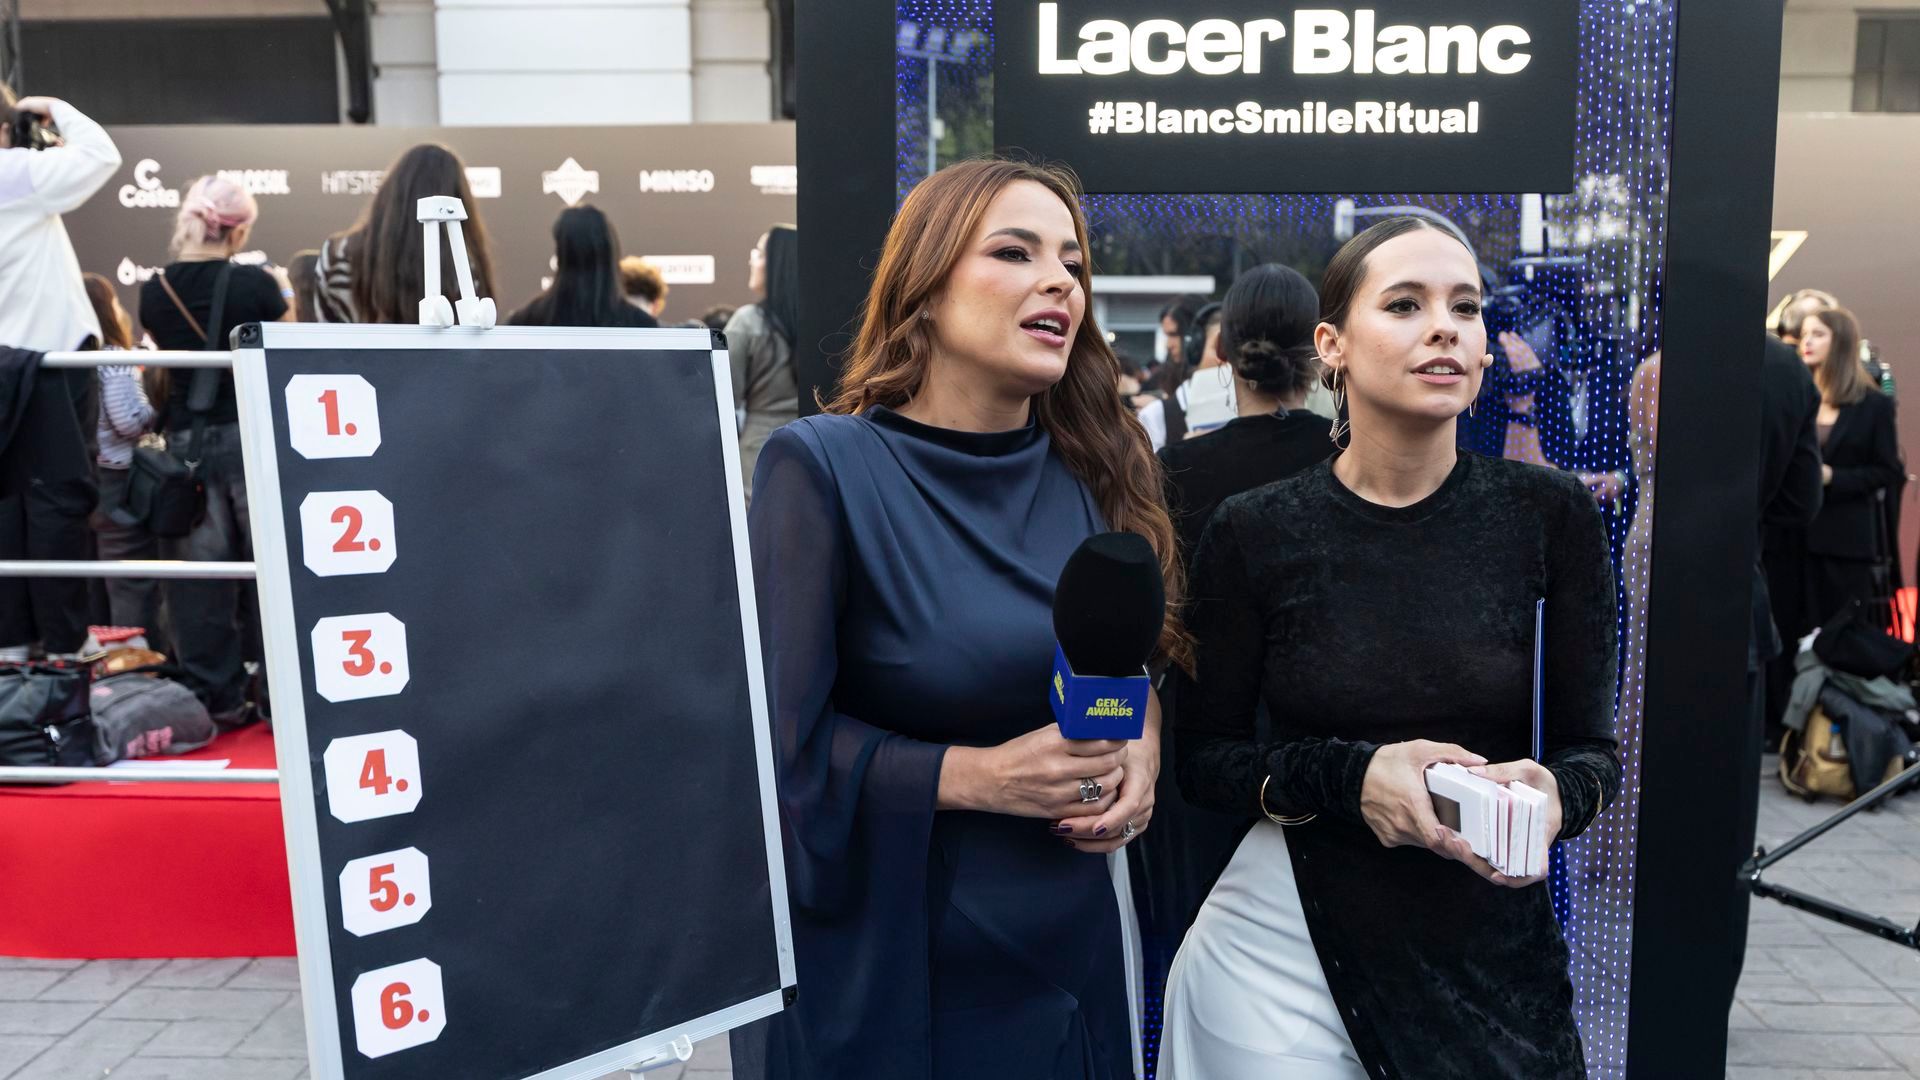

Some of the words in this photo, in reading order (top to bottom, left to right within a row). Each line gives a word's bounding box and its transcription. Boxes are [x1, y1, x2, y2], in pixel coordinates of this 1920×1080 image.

[1038, 2, 1286, 75] Lacer
[1293, 8, 1532, 75] Blanc
[1088, 101, 1480, 135] #BlancSmileRitual
[118, 184, 181, 208] Costa
[639, 169, 715, 193] MINISO
[317, 389, 358, 436] 1.
[330, 505, 381, 552] 2.
[342, 629, 393, 677] 3.
[1085, 706, 1134, 716] AWARDS
[359, 748, 409, 796] 4.
[369, 863, 416, 912] 5.
[380, 981, 430, 1030] 6.
